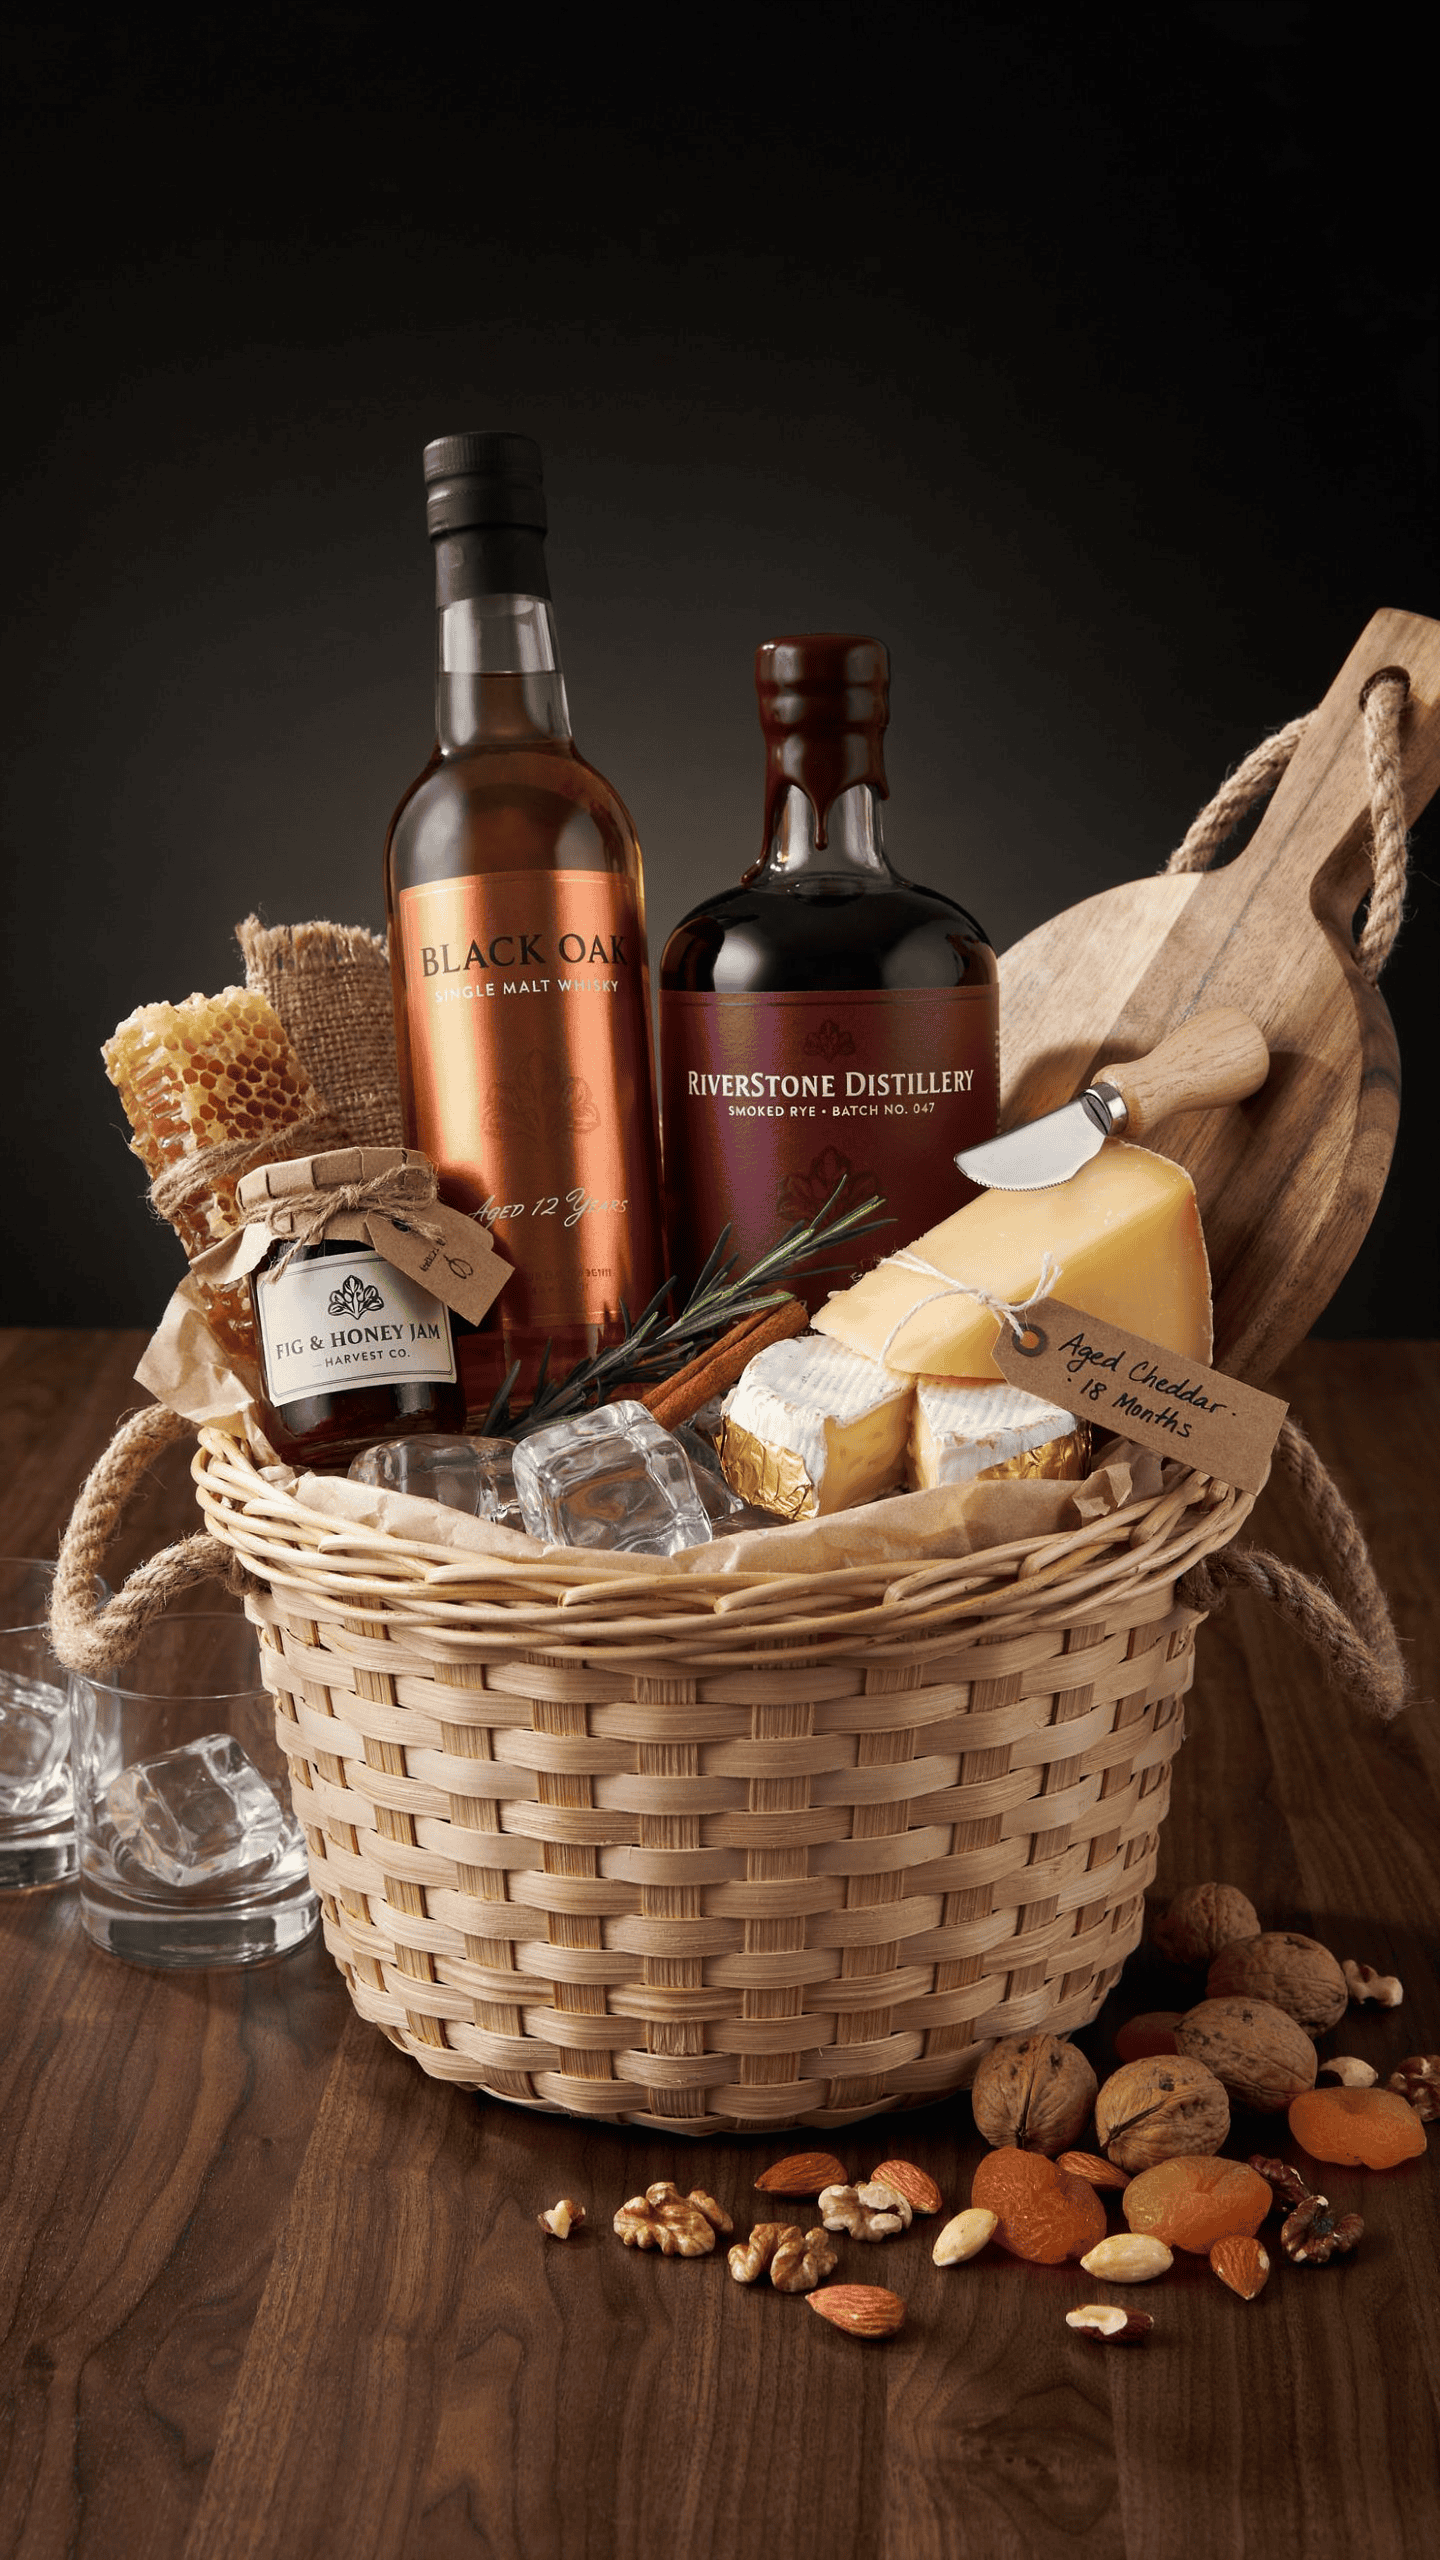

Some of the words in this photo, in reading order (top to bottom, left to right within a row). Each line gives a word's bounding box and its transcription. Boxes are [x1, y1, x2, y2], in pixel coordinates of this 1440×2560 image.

[421, 933, 546, 977] BLACK
[558, 933, 628, 966] OAK
[435, 982, 495, 1003] SINGLE
[503, 979, 550, 995] MALT
[558, 979, 619, 993] WHISKY
[728, 1105, 785, 1117] SMOKED
[790, 1106, 816, 1117] RYE
[832, 1105, 877, 1117] BATCH
[884, 1103, 908, 1115] NO.
[913, 1102, 935, 1114] 047
[531, 1197, 559, 1216] 12
[275, 1339, 304, 1360] FIG
[310, 1336, 325, 1351] &
[330, 1324, 404, 1348] HONEY
[410, 1323, 441, 1342] JAM
[325, 1350, 384, 1368] HARVEST
[389, 1349, 410, 1359] CO.
[1058, 1333, 1126, 1373] Aged
[1128, 1361, 1228, 1414] Cheddar
[1079, 1378, 1107, 1401] 18
[1111, 1392, 1193, 1439] Months
